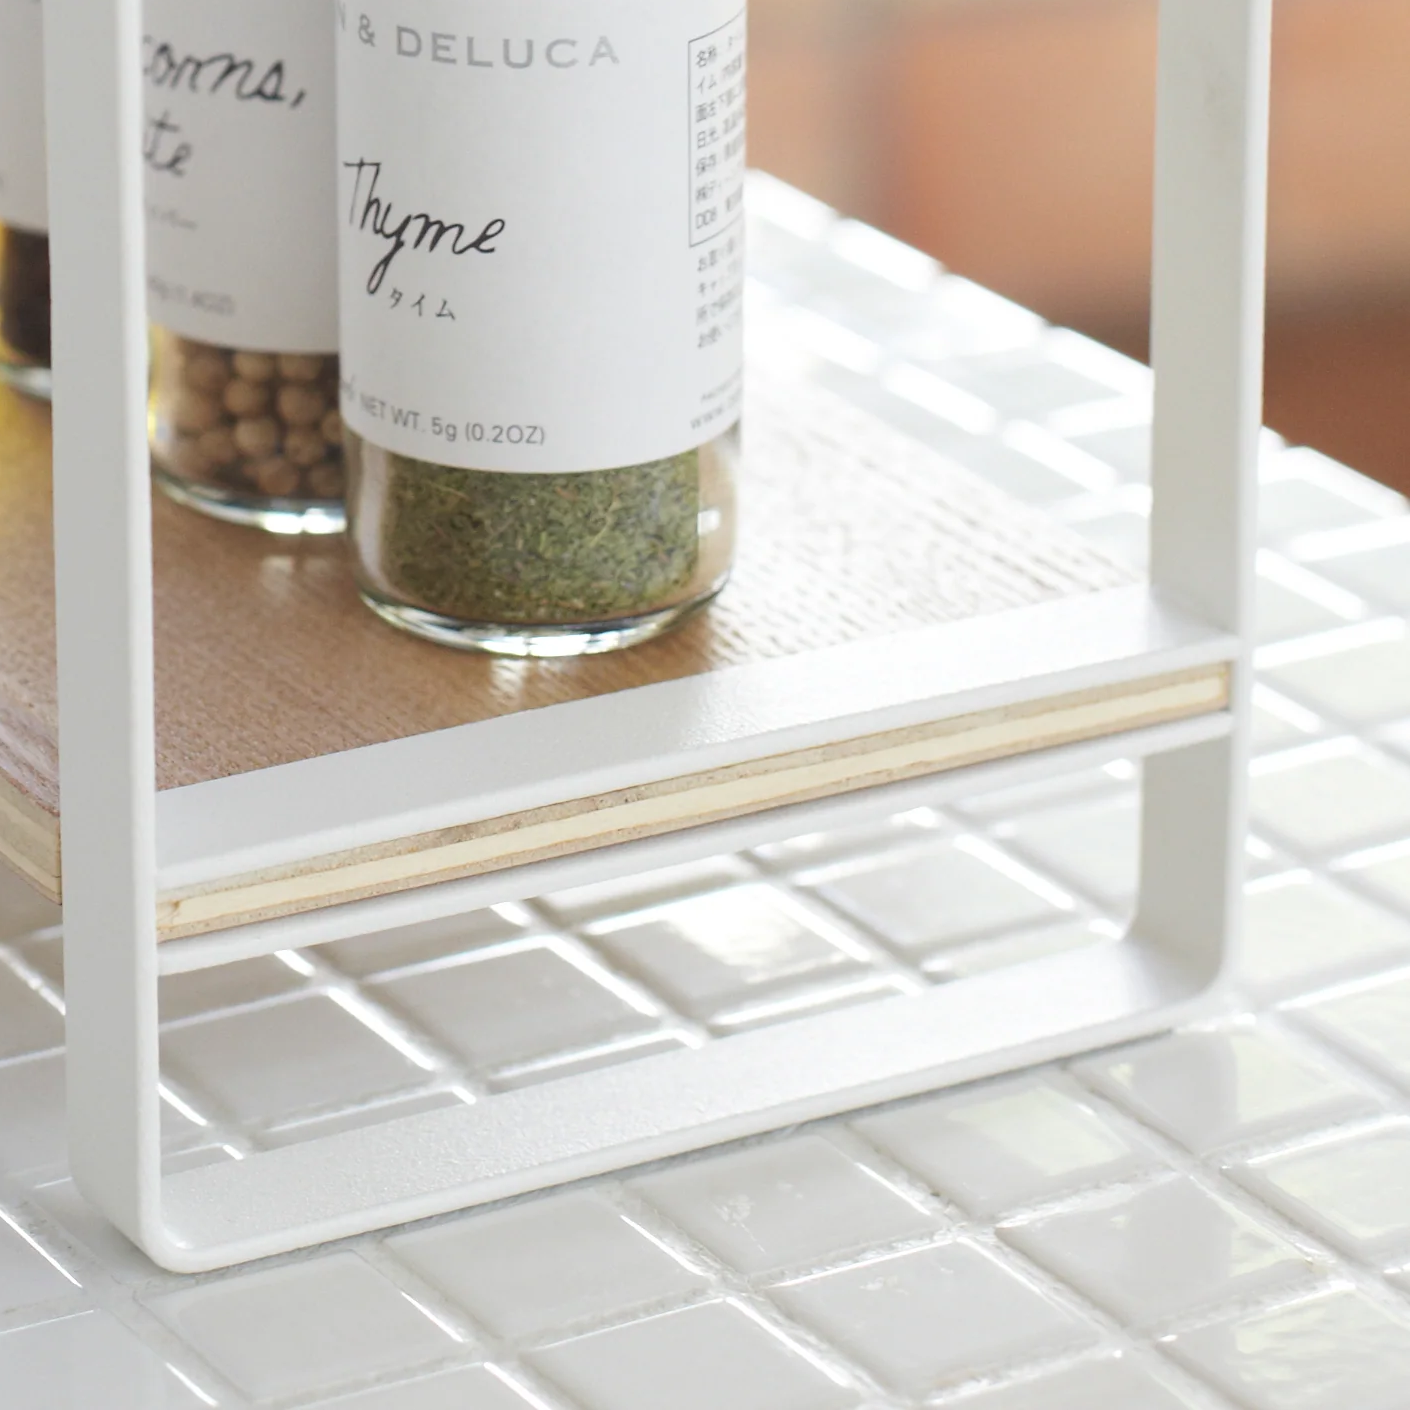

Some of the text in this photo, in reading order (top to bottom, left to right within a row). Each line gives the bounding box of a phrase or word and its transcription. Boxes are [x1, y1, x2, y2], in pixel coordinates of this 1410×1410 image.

[357, 12, 377, 49] &
[395, 24, 621, 70] DELUCA
[343, 157, 506, 295] Thyme
[391, 287, 456, 321] タイム
[359, 394, 387, 420] NET
[391, 405, 427, 434] WT.
[432, 416, 458, 442] 5g
